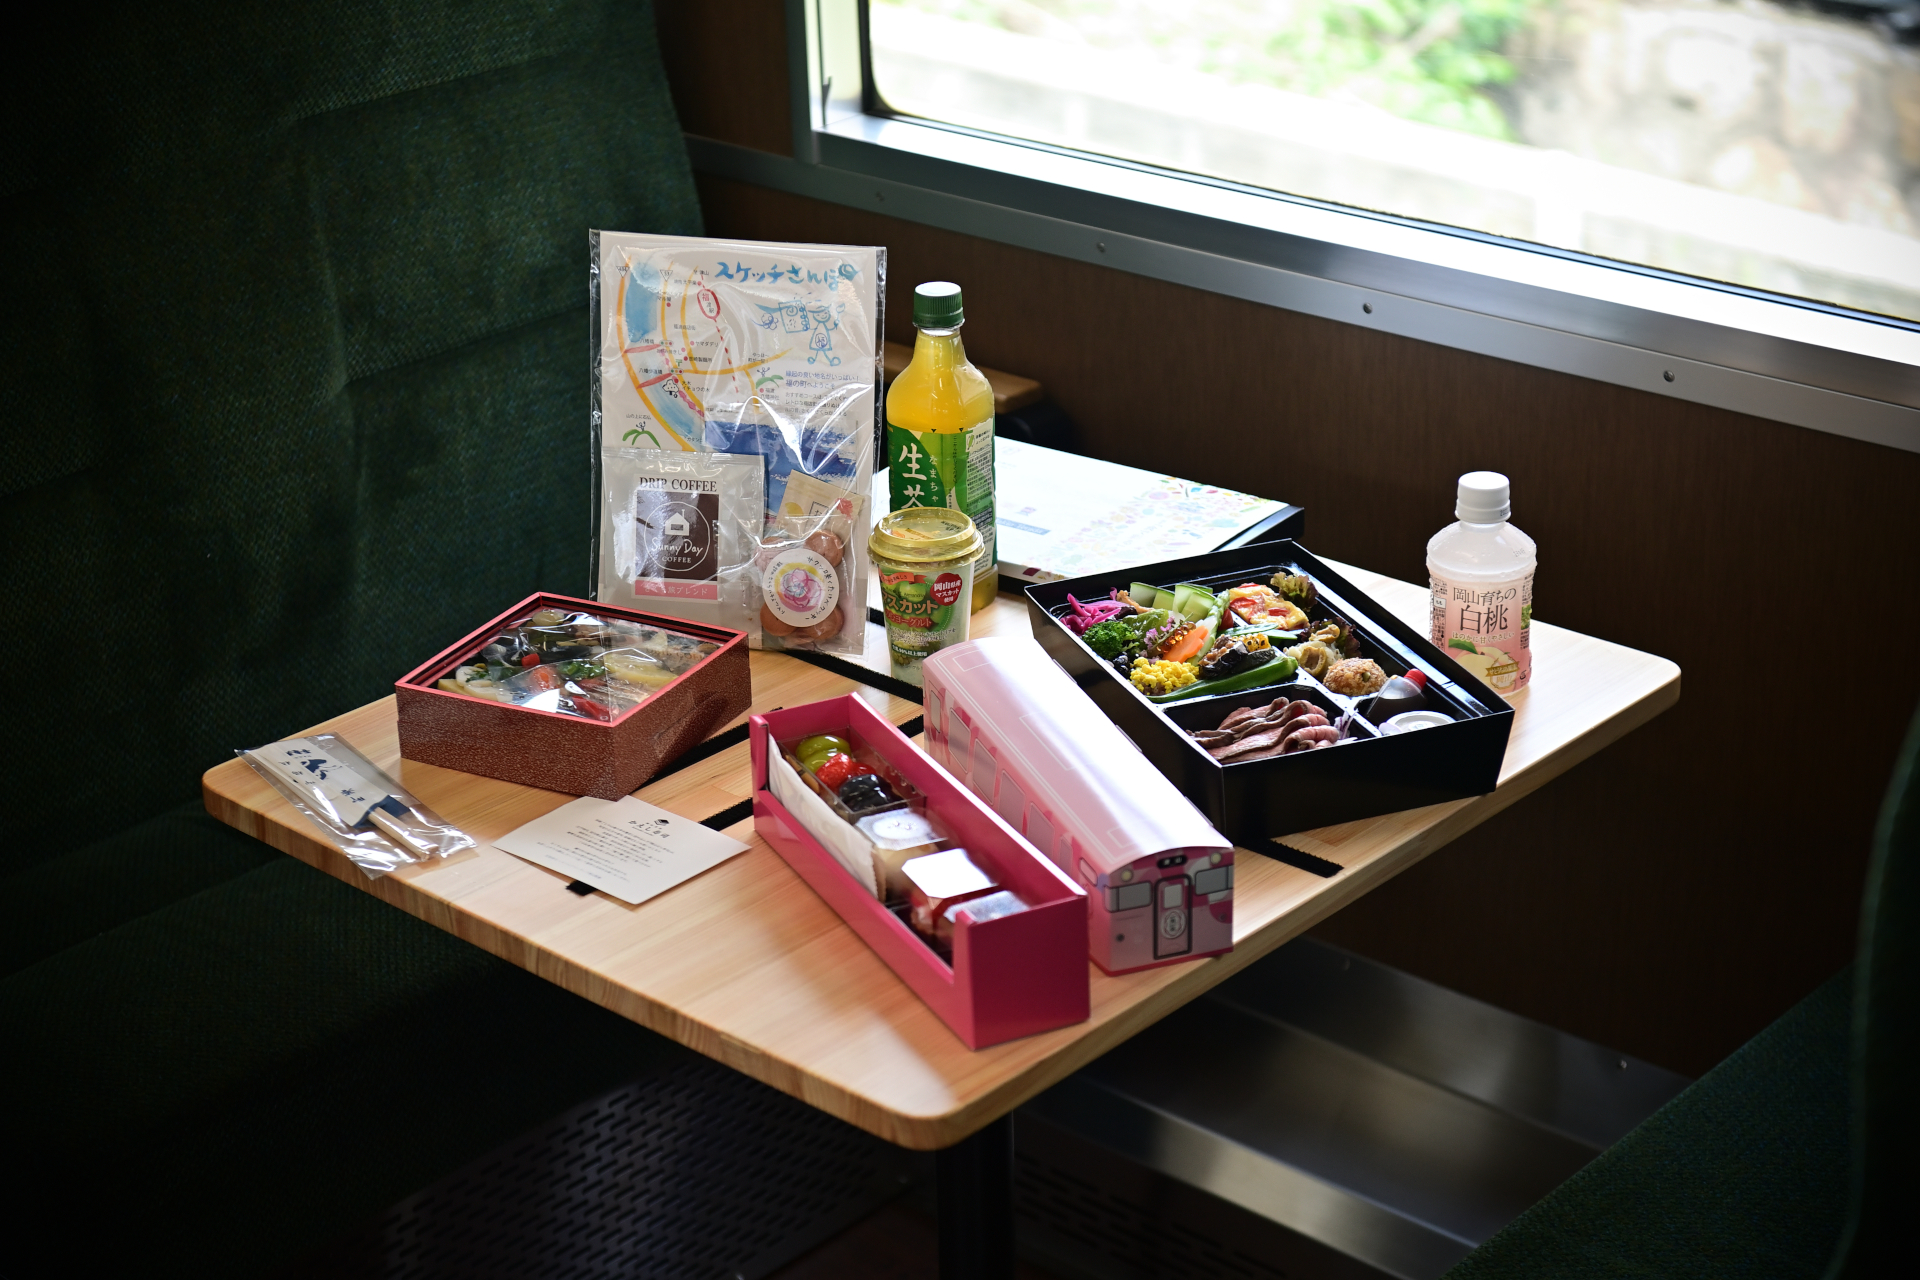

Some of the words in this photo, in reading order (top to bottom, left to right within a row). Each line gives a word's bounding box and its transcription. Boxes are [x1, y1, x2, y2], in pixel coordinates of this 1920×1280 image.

[640, 476, 668, 489] DRIP
[671, 478, 717, 492] COFFEE
[929, 454, 939, 503] なまちゃ
[651, 536, 682, 555] Sunny
[684, 539, 704, 556] Day
[935, 588, 960, 598] マスカット
[1453, 586, 1517, 606] 岡山育ちの
[1460, 604, 1509, 634] 白桃
